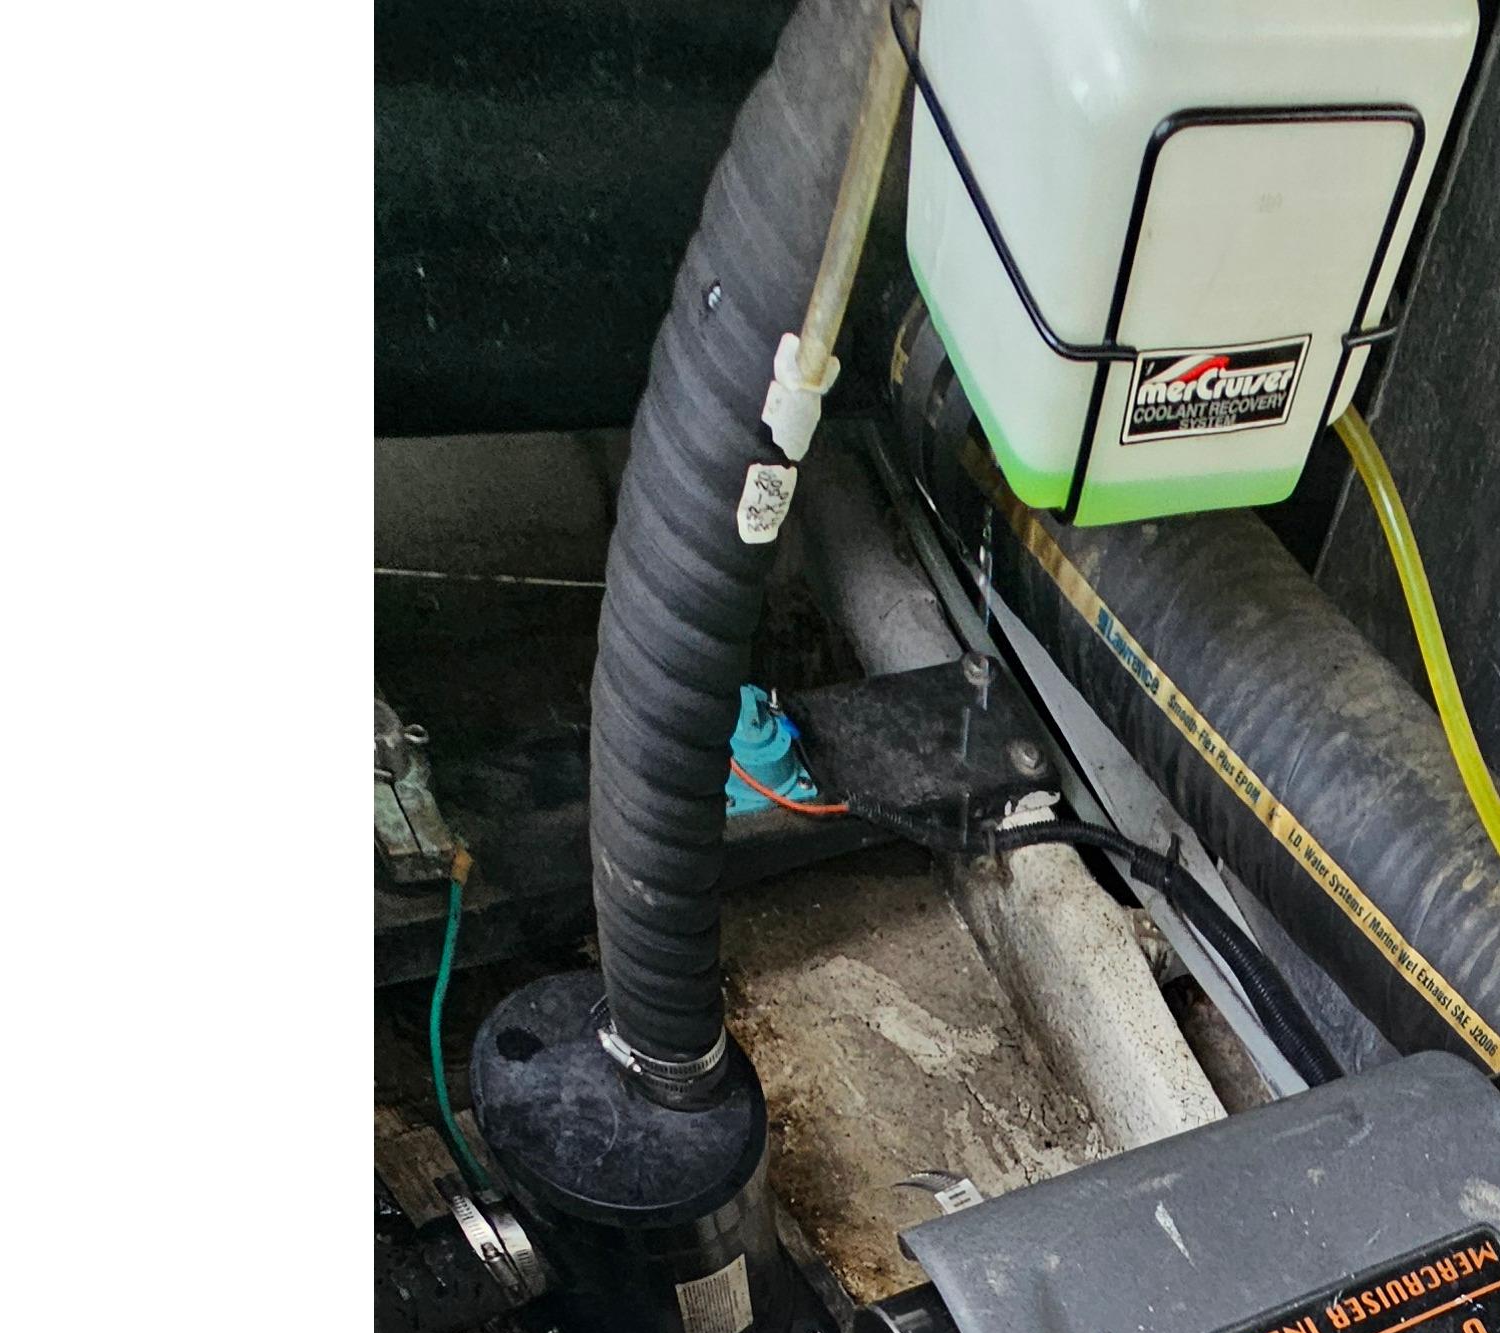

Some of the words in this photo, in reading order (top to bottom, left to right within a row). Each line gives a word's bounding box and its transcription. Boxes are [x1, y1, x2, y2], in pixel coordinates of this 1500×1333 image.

[1133, 400, 1208, 424] COOLANT
[1207, 391, 1288, 420] RECOVERY
[1178, 413, 1238, 431] SYSTEM
[1216, 751, 1236, 777] Plus
[1285, 828, 1307, 852] I.D.
[1301, 847, 1331, 879] Water
[1325, 873, 1367, 919] Systems
[1366, 917, 1402, 956] Marine
[1396, 948, 1419, 974] Wet
[1414, 967, 1454, 1011] Exhaust
[1448, 1003, 1471, 1028] SAE
[1467, 1023, 1499, 1058] J2006
[1326, 1241, 1498, 1330] MERCRUISER
